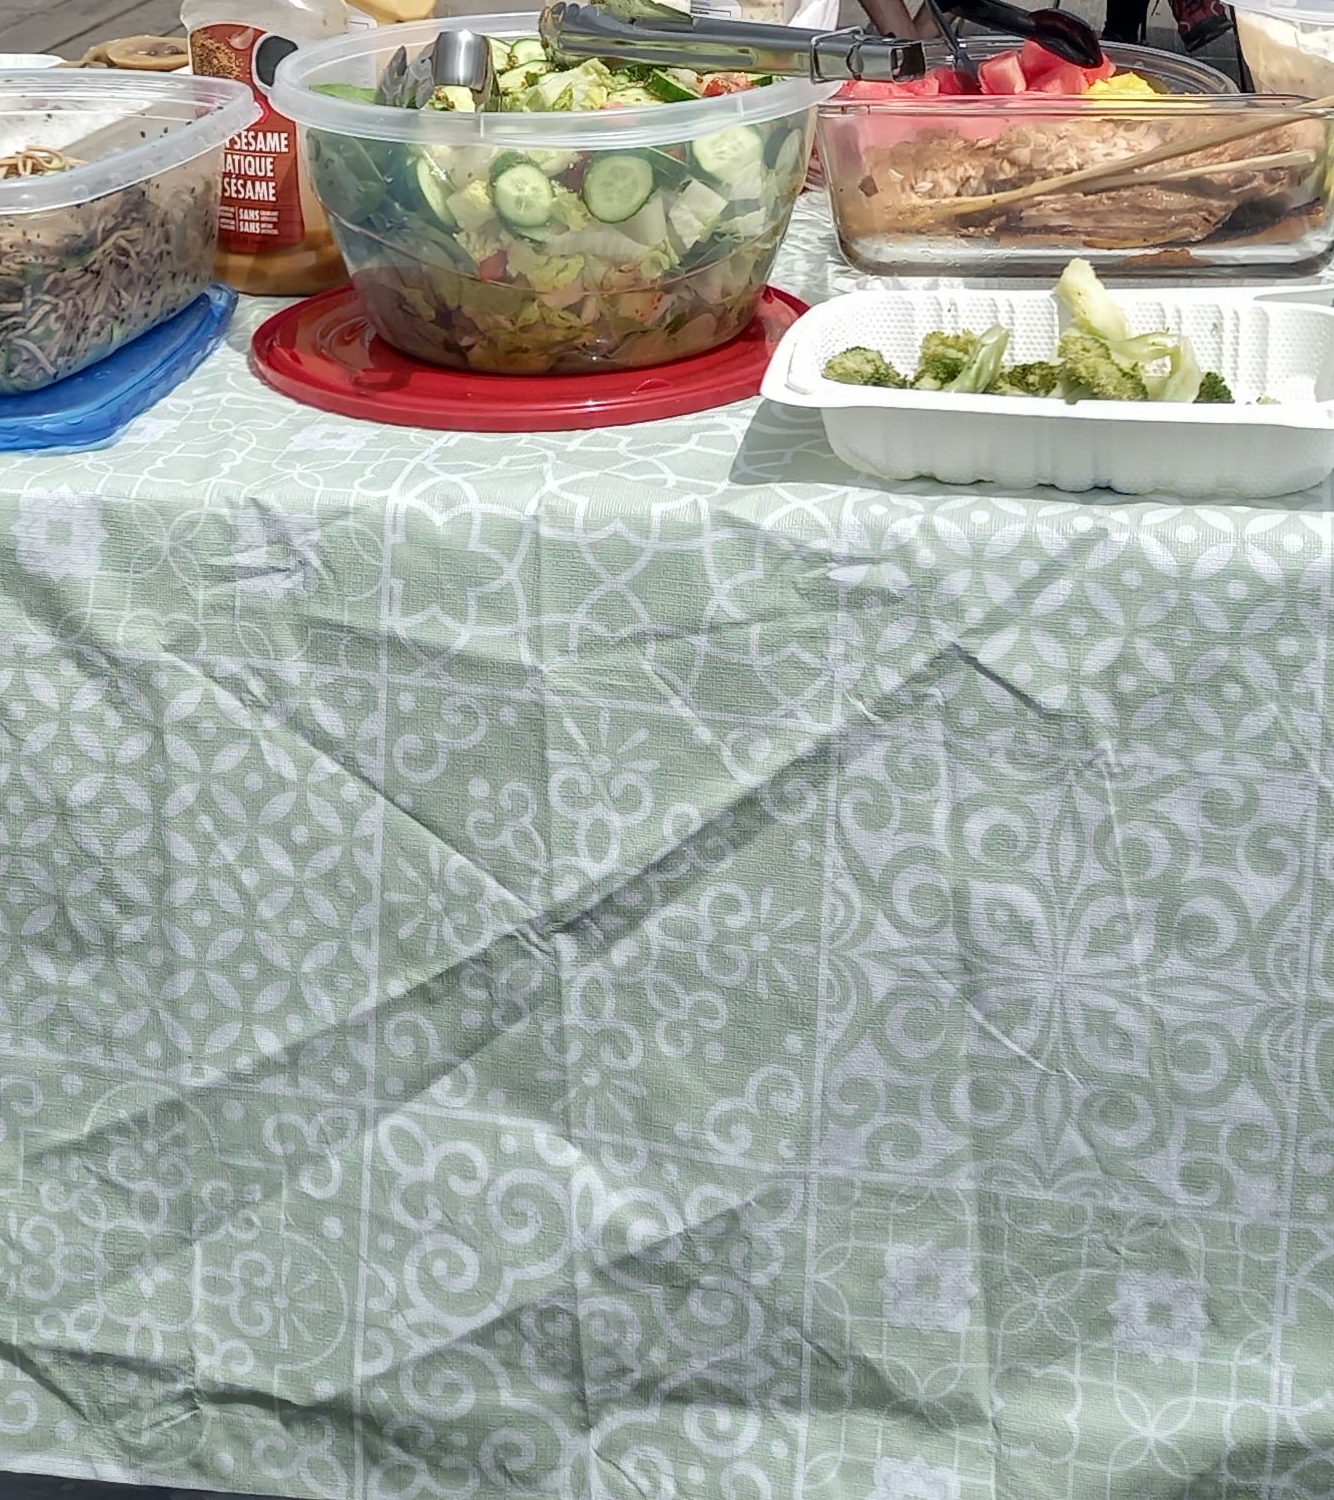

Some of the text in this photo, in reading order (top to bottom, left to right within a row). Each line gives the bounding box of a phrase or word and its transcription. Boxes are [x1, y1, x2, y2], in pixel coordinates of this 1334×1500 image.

[226, 154, 274, 177] ATIQUE
[223, 174, 277, 201] SÉSAME
[239, 208, 260, 220] SANS
[239, 221, 261, 233] SANS
